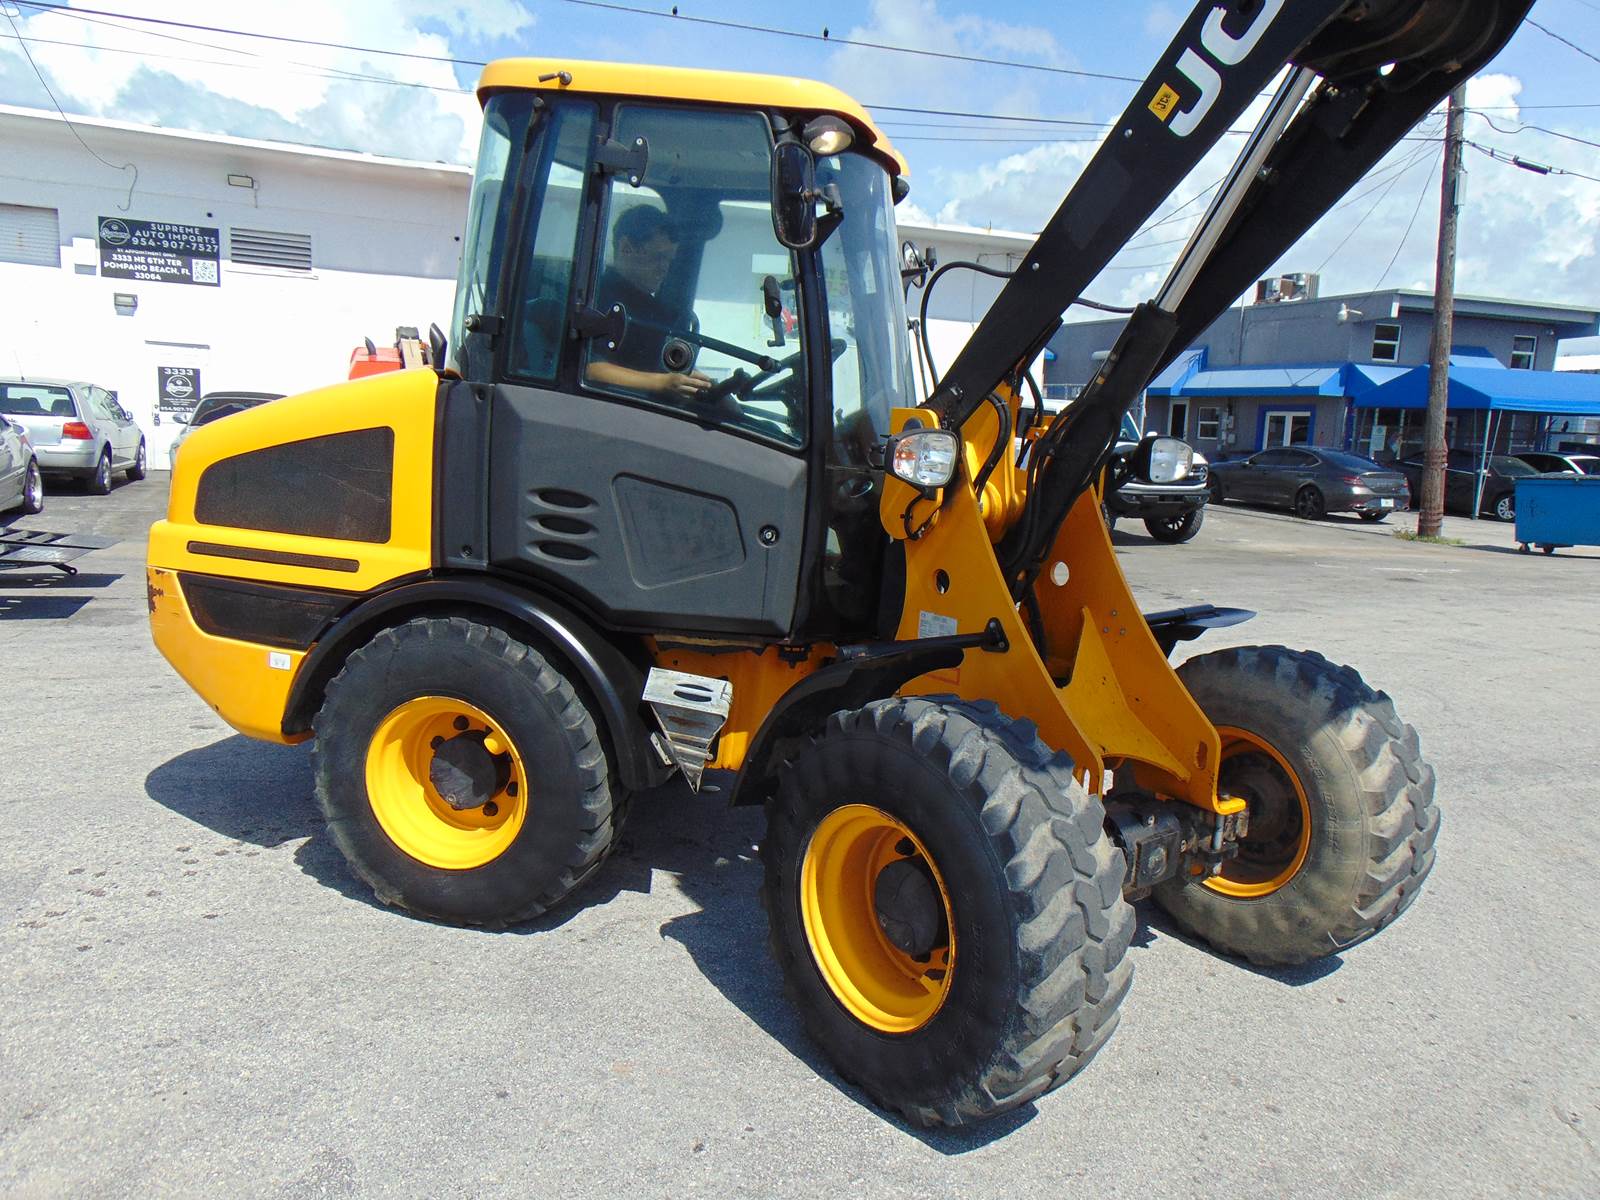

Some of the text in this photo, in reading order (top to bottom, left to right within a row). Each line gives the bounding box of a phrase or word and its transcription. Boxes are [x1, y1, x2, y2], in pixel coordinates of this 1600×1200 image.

[150, 223, 201, 235] SUPREME
[134, 230, 165, 239] AUTO
[168, 233, 217, 244] IMPORTS
[131, 237, 218, 252] 954-907-7527
[111, 253, 182, 266] 3333 NE 6TH TER
[103, 261, 191, 276] POMPANO BEACH, FL
[134, 272, 162, 281] 33064
[164, 368, 194, 376] 3333
